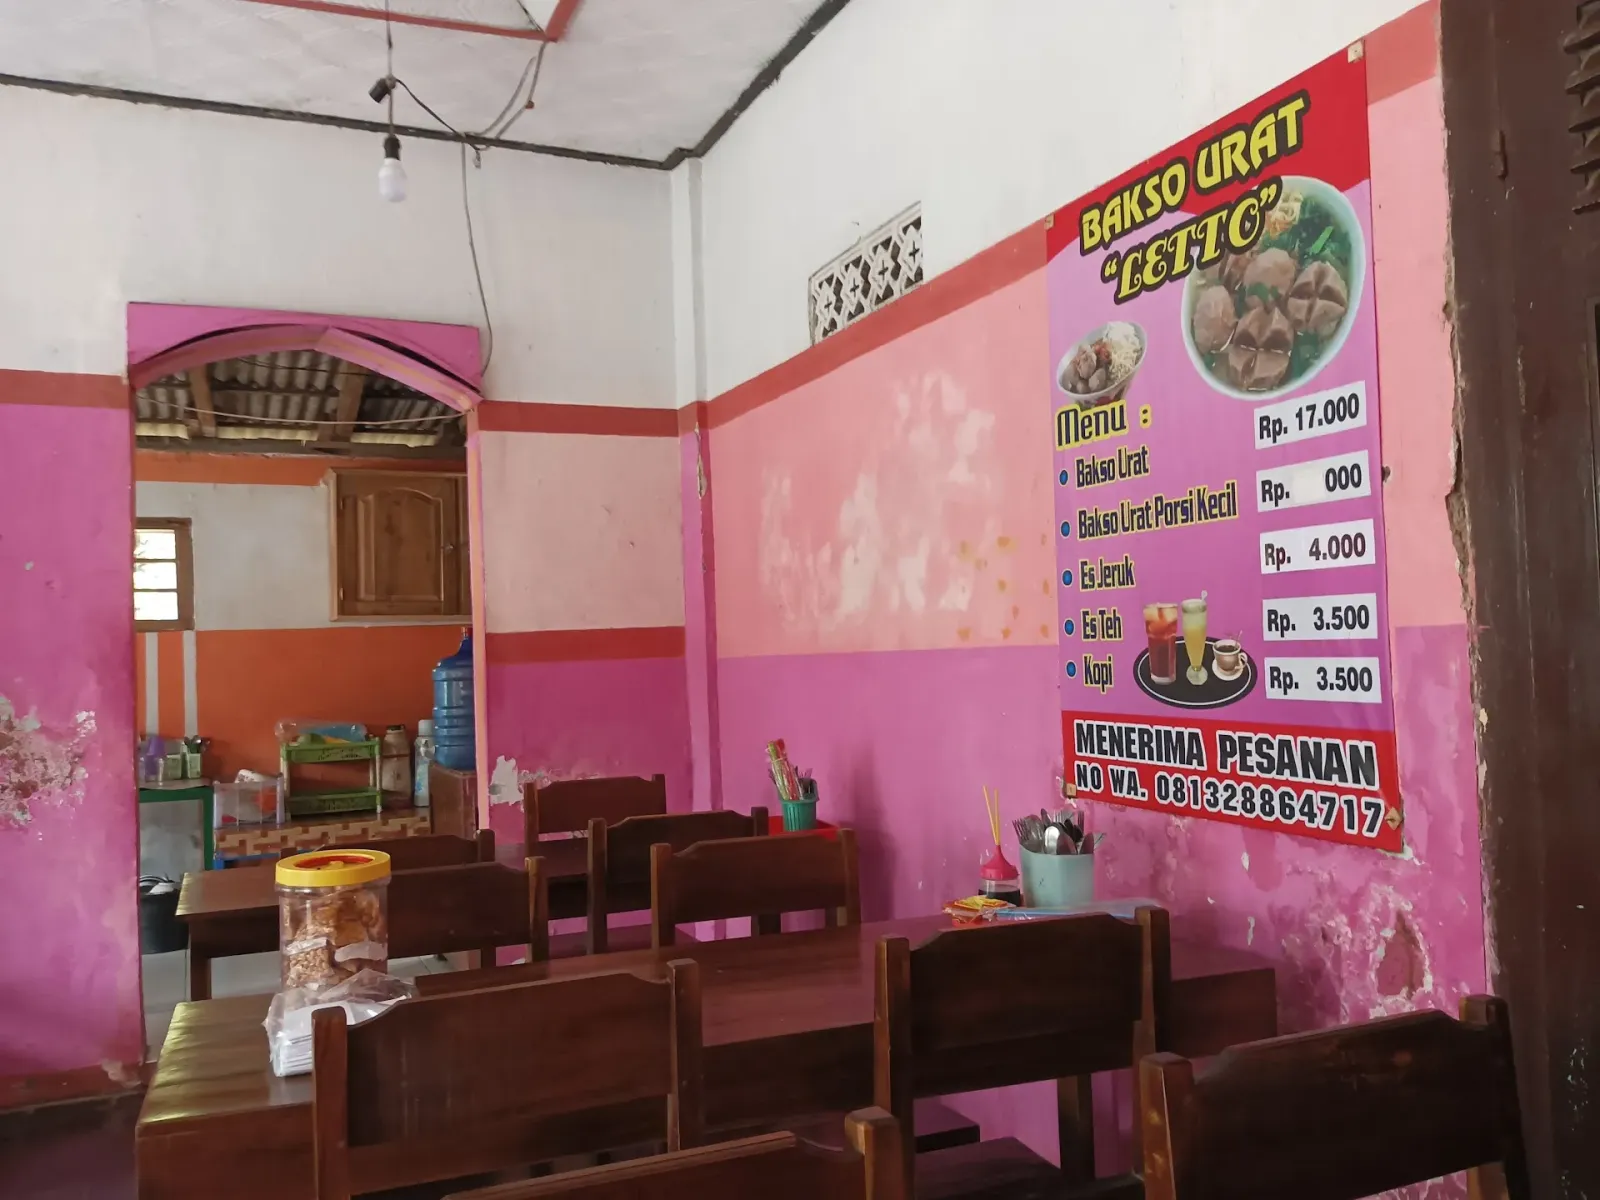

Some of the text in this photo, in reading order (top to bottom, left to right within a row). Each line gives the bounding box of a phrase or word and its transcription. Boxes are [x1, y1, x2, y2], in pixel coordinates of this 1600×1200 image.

[1081, 96, 1305, 251] BAKSO URAT
[1056, 402, 1128, 448] Menu
[1258, 392, 1361, 445] Rp. 17.000
[1075, 446, 1149, 488] Bakso Urat
[1078, 482, 1237, 540] Bakso Urat Porsi Kecil
[1261, 479, 1291, 512] Rp.
[1264, 532, 1367, 572] Rp. 4.000
[1080, 556, 1135, 590] Es Jeruk
[1082, 609, 1123, 640] Es Teh
[1267, 604, 1371, 638] Rp. 3.500
[1083, 656, 1114, 692] Kopi
[1269, 666, 1374, 698] Rp. 3.500
[1074, 721, 1380, 788] MENERIMA PESANAN
[1075, 762, 1384, 836] NO WA. 081328864717
